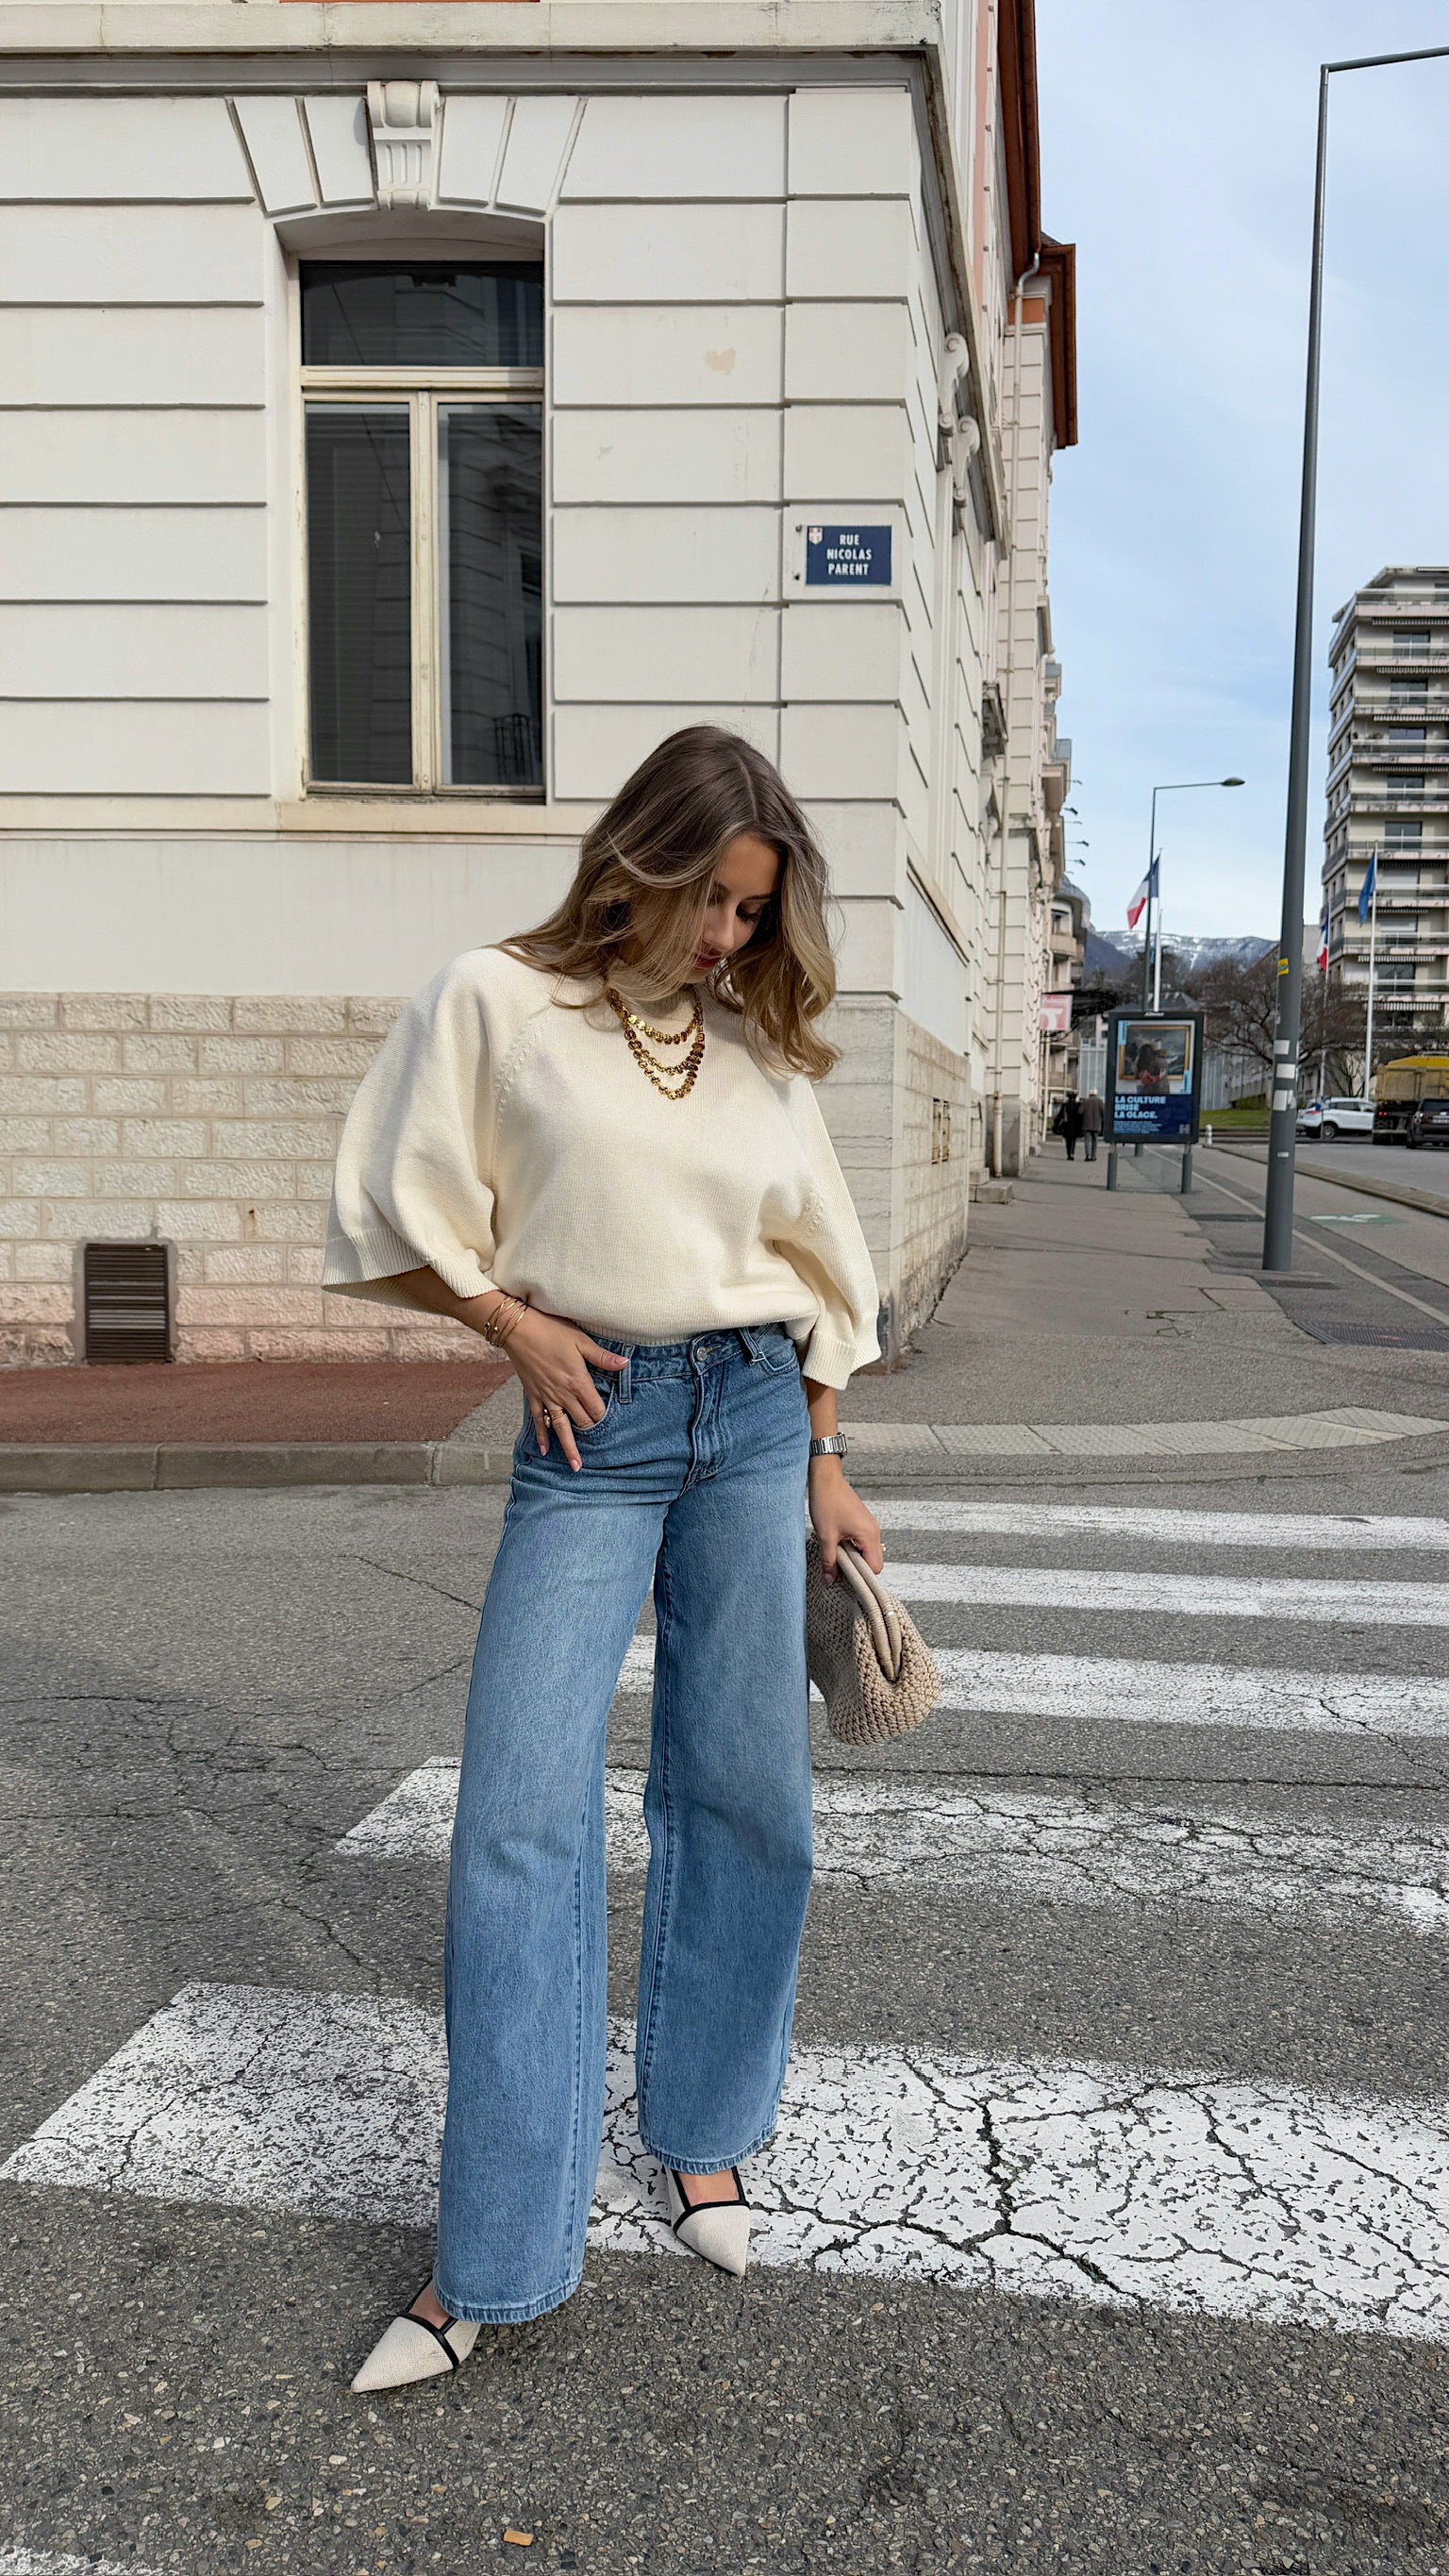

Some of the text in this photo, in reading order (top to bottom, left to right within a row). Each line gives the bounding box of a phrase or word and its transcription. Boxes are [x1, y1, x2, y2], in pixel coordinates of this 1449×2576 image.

[839, 534, 860, 545] RUE
[826, 548, 873, 560] NICOLAS
[827, 563, 869, 576] PARENT
[1115, 1096, 1166, 1104] LA CULTURE
[1114, 1111, 1158, 1119] LA GLACE.
